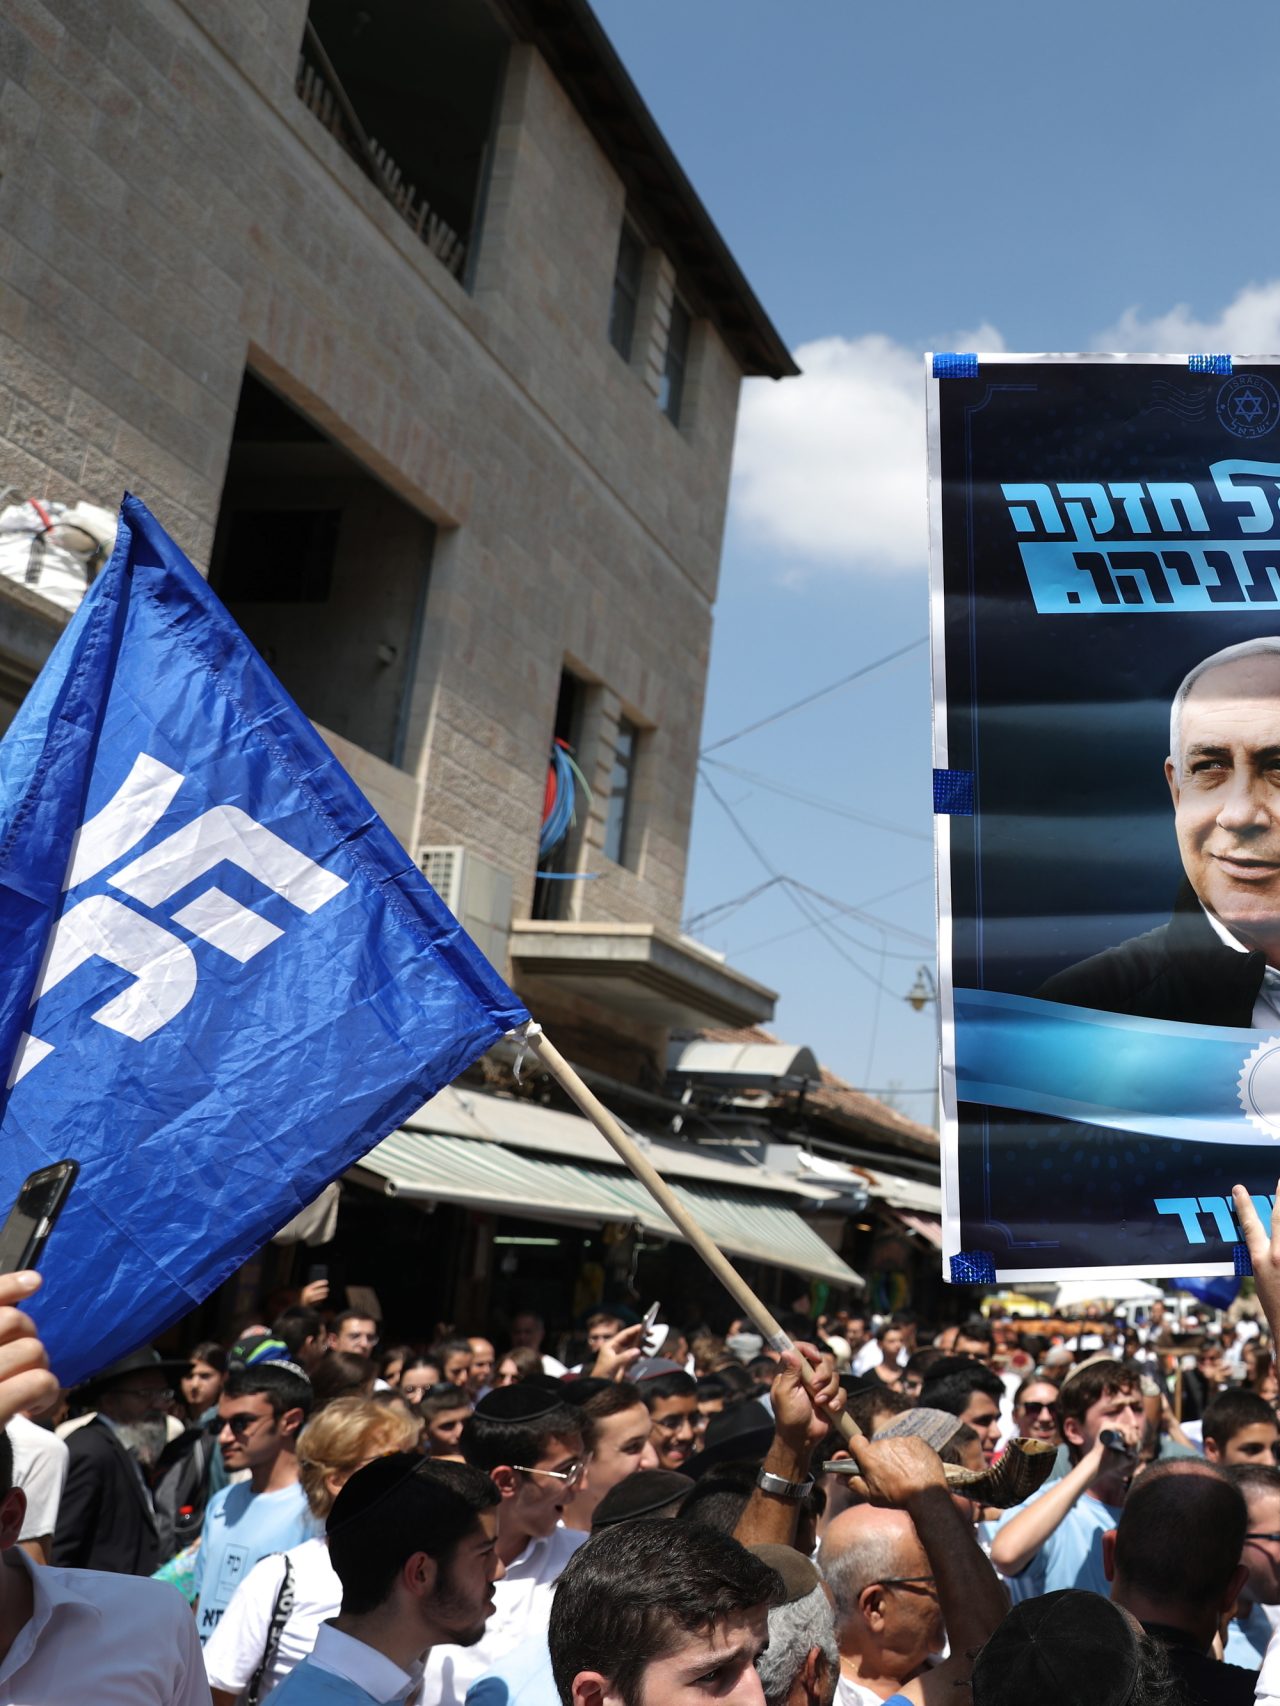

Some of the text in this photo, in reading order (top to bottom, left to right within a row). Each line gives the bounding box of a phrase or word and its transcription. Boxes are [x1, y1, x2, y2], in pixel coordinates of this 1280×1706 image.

[1230, 376, 1265, 389] ISRAEL
[1230, 419, 1270, 435] ישראל
[1001, 483, 1210, 542] חזקה
